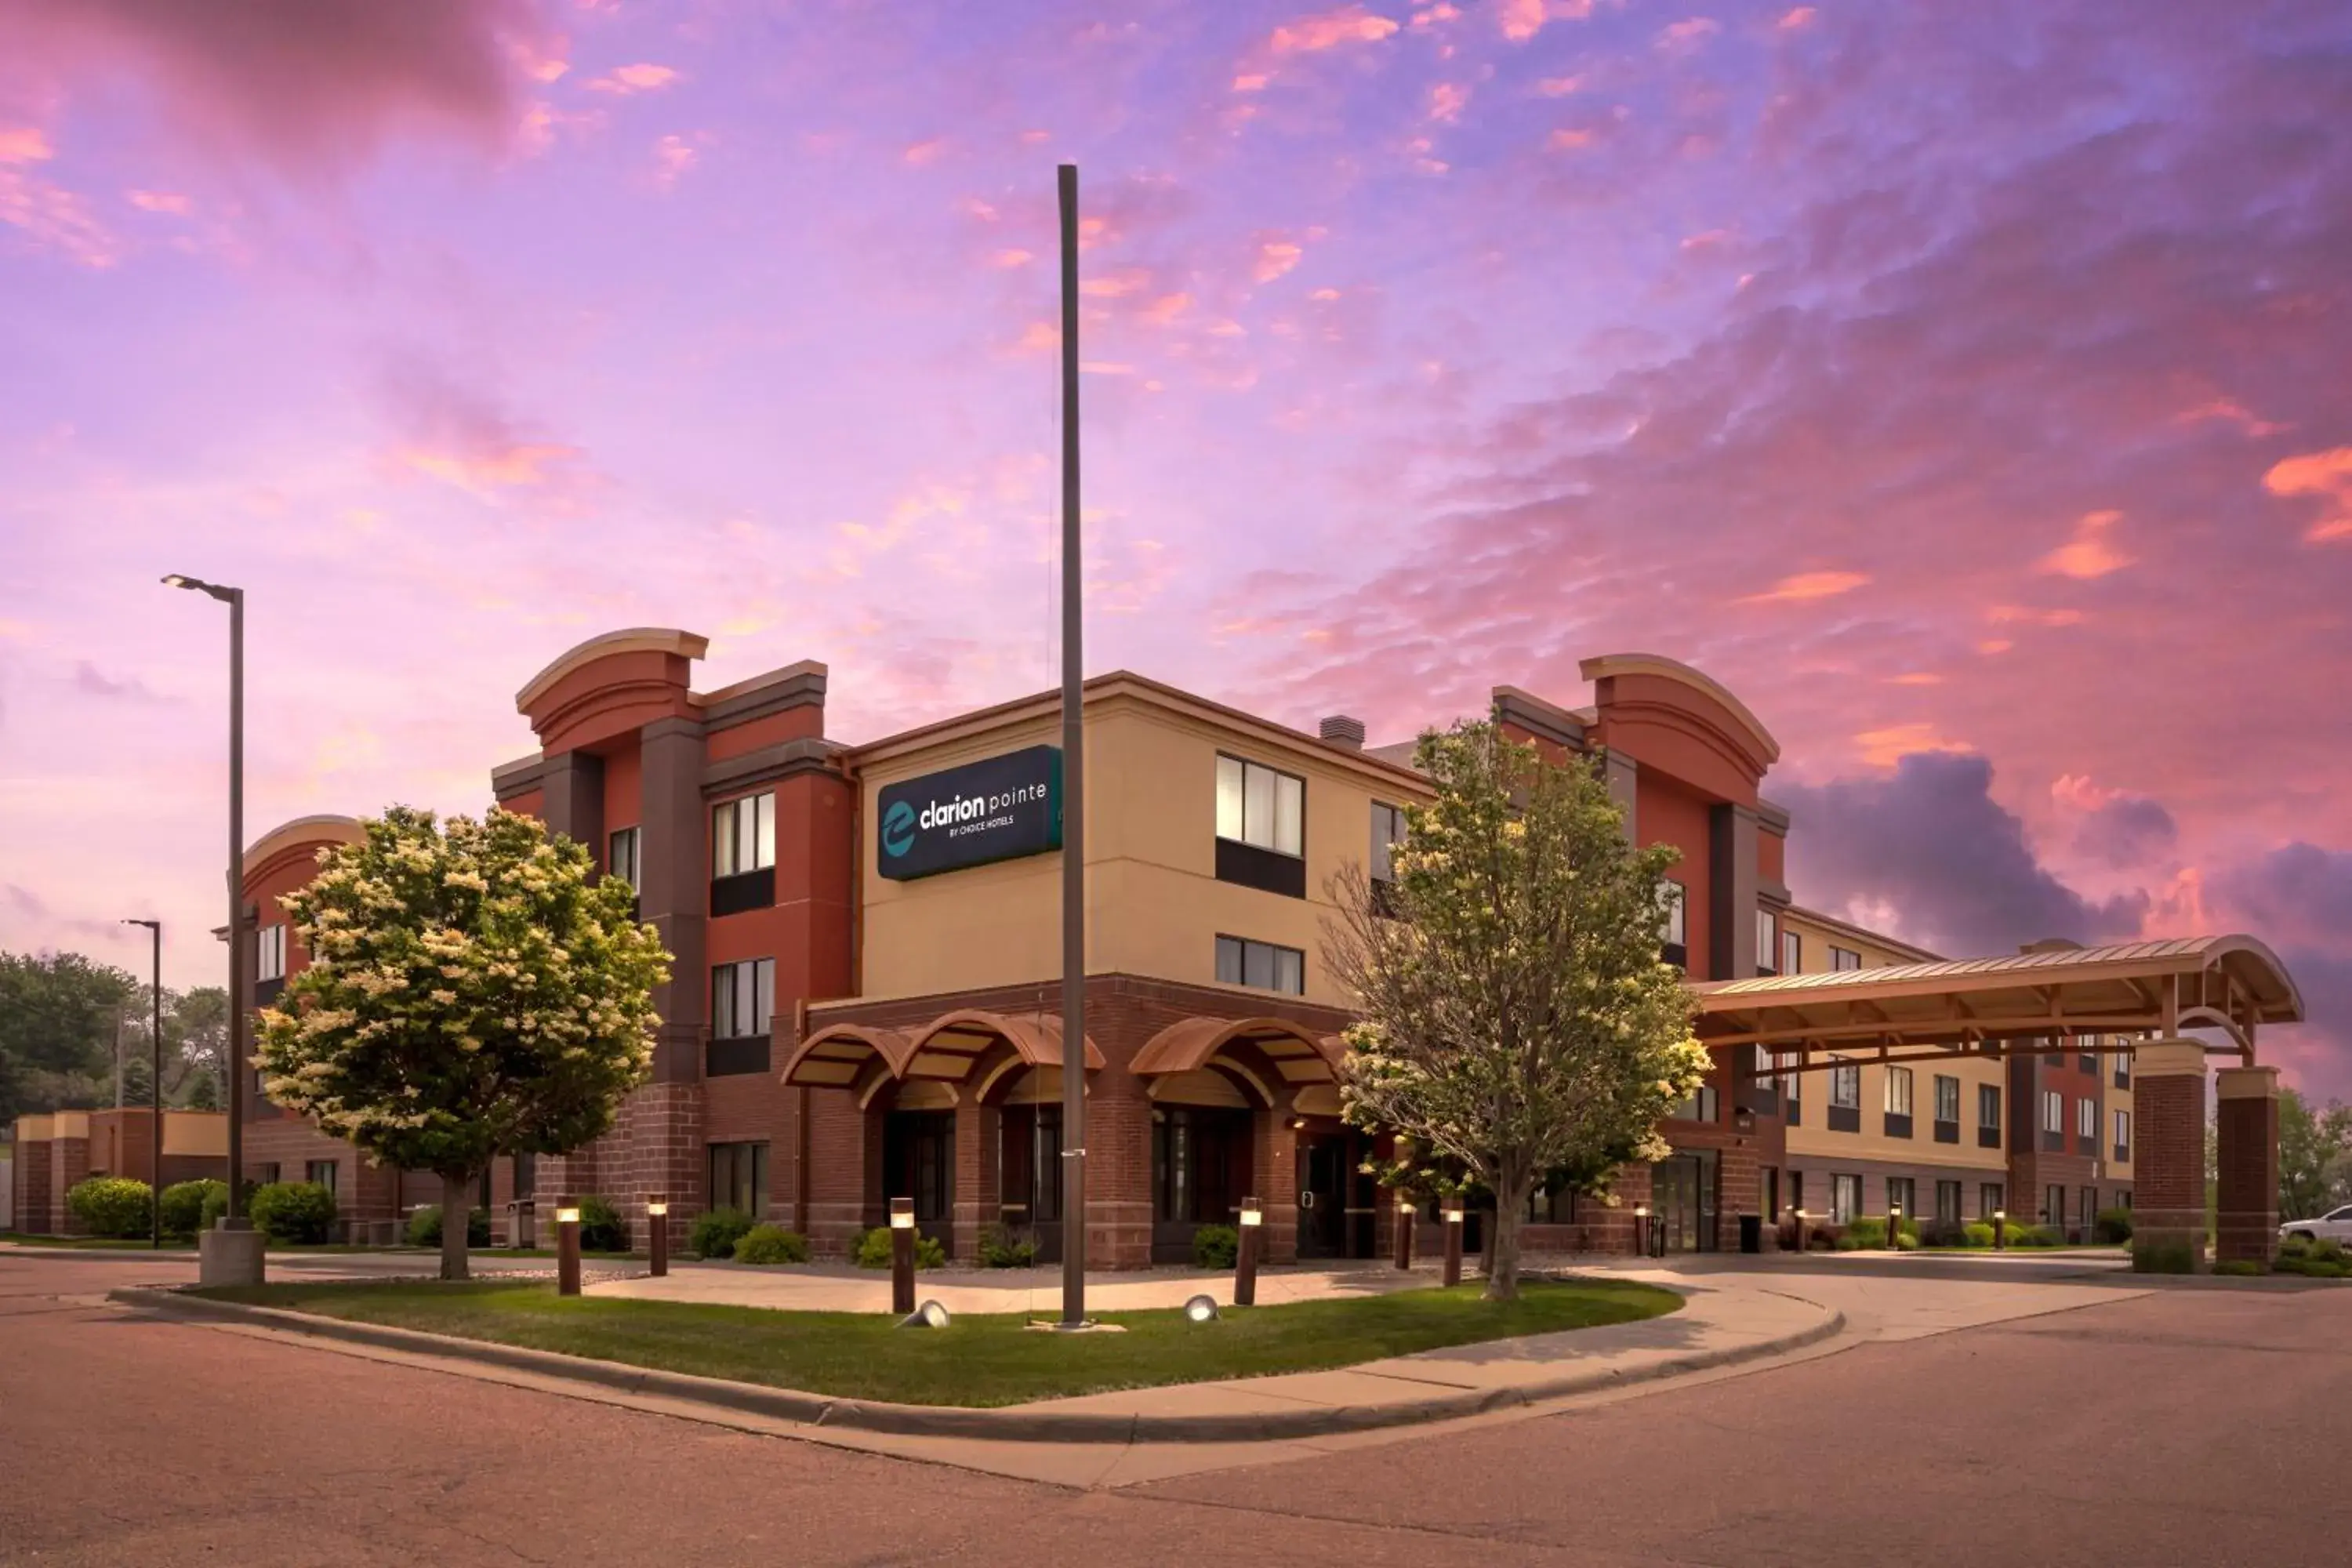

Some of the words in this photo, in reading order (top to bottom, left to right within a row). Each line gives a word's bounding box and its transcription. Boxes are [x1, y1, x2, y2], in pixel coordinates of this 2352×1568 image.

[920, 794, 984, 829] clarion
[989, 783, 1047, 815] pointe
[949, 828, 958, 838] BY
[959, 820, 985, 835] CHOICE
[986, 815, 1014, 828] HOTELS
